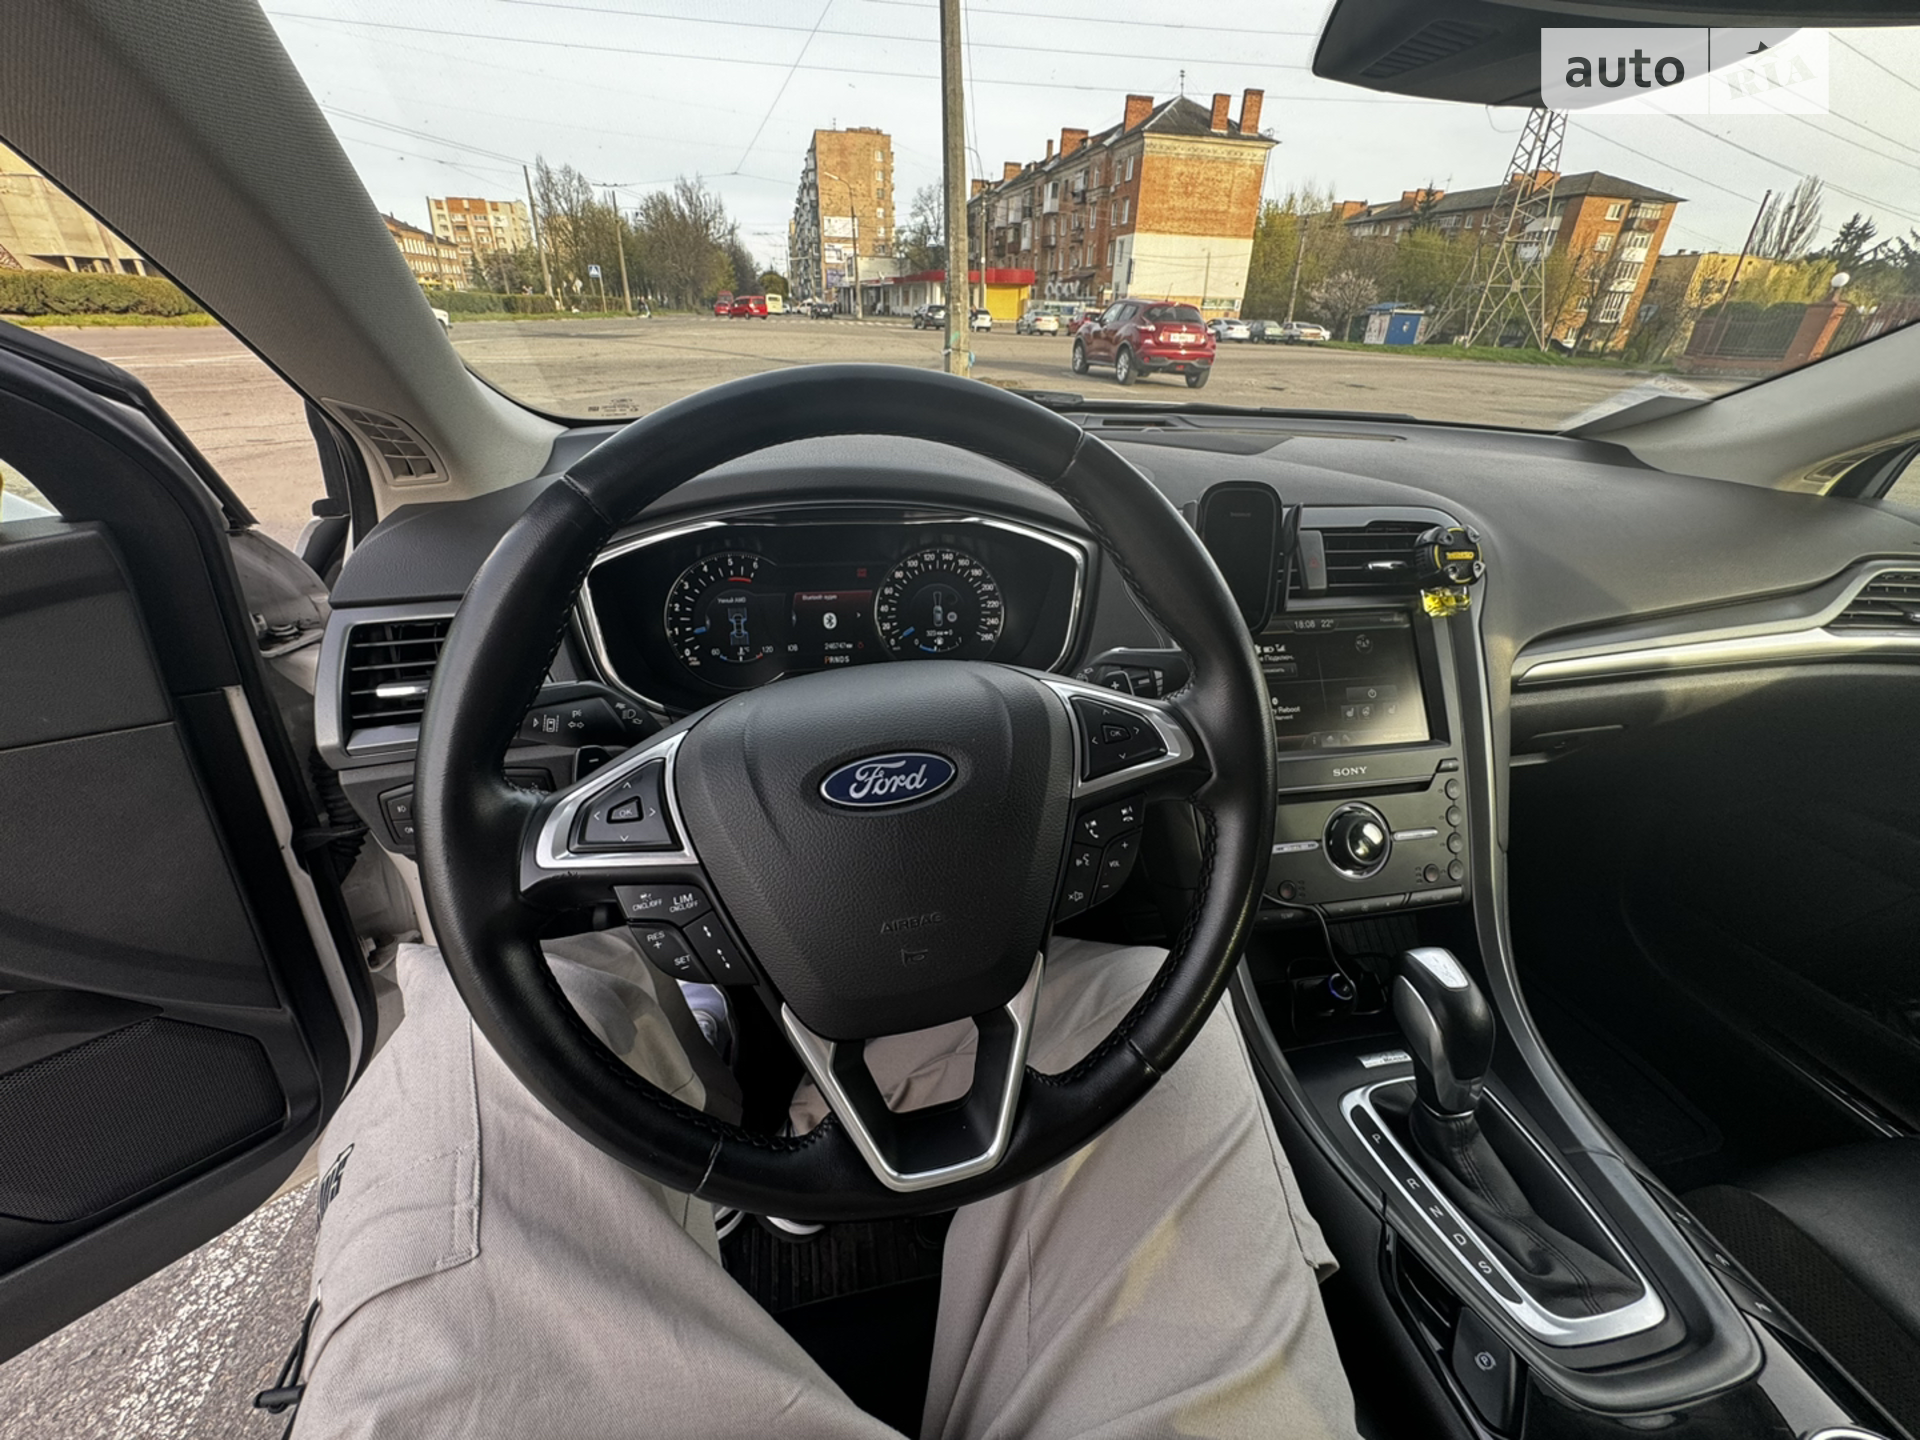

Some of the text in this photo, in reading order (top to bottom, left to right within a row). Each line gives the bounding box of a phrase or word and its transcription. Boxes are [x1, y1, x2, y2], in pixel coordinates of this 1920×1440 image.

[728, 558, 733, 566] 5
[753, 561, 758, 569] 6
[702, 564, 708, 572] 4
[683, 581, 689, 589] 3
[884, 587, 893, 595] 60
[674, 603, 680, 611] 2
[882, 622, 891, 630] 20
[674, 627, 679, 635] 1
[684, 648, 690, 656] 0
[711, 648, 720, 656] 60
[762, 645, 774, 653] 120
[1332, 766, 1367, 777] SONY
[849, 760, 927, 799] Ford
[619, 809, 633, 817] OK
[1108, 859, 1120, 867] VOL
[673, 893, 693, 905] LIM
[880, 911, 941, 933] AIRBAG
[647, 931, 665, 942] RES
[674, 954, 691, 966] SET
[1372, 1133, 1382, 1144] P
[1406, 1177, 1420, 1189] R
[1429, 1205, 1444, 1218] N
[1453, 1233, 1467, 1246] D
[1478, 1260, 1492, 1274] S
